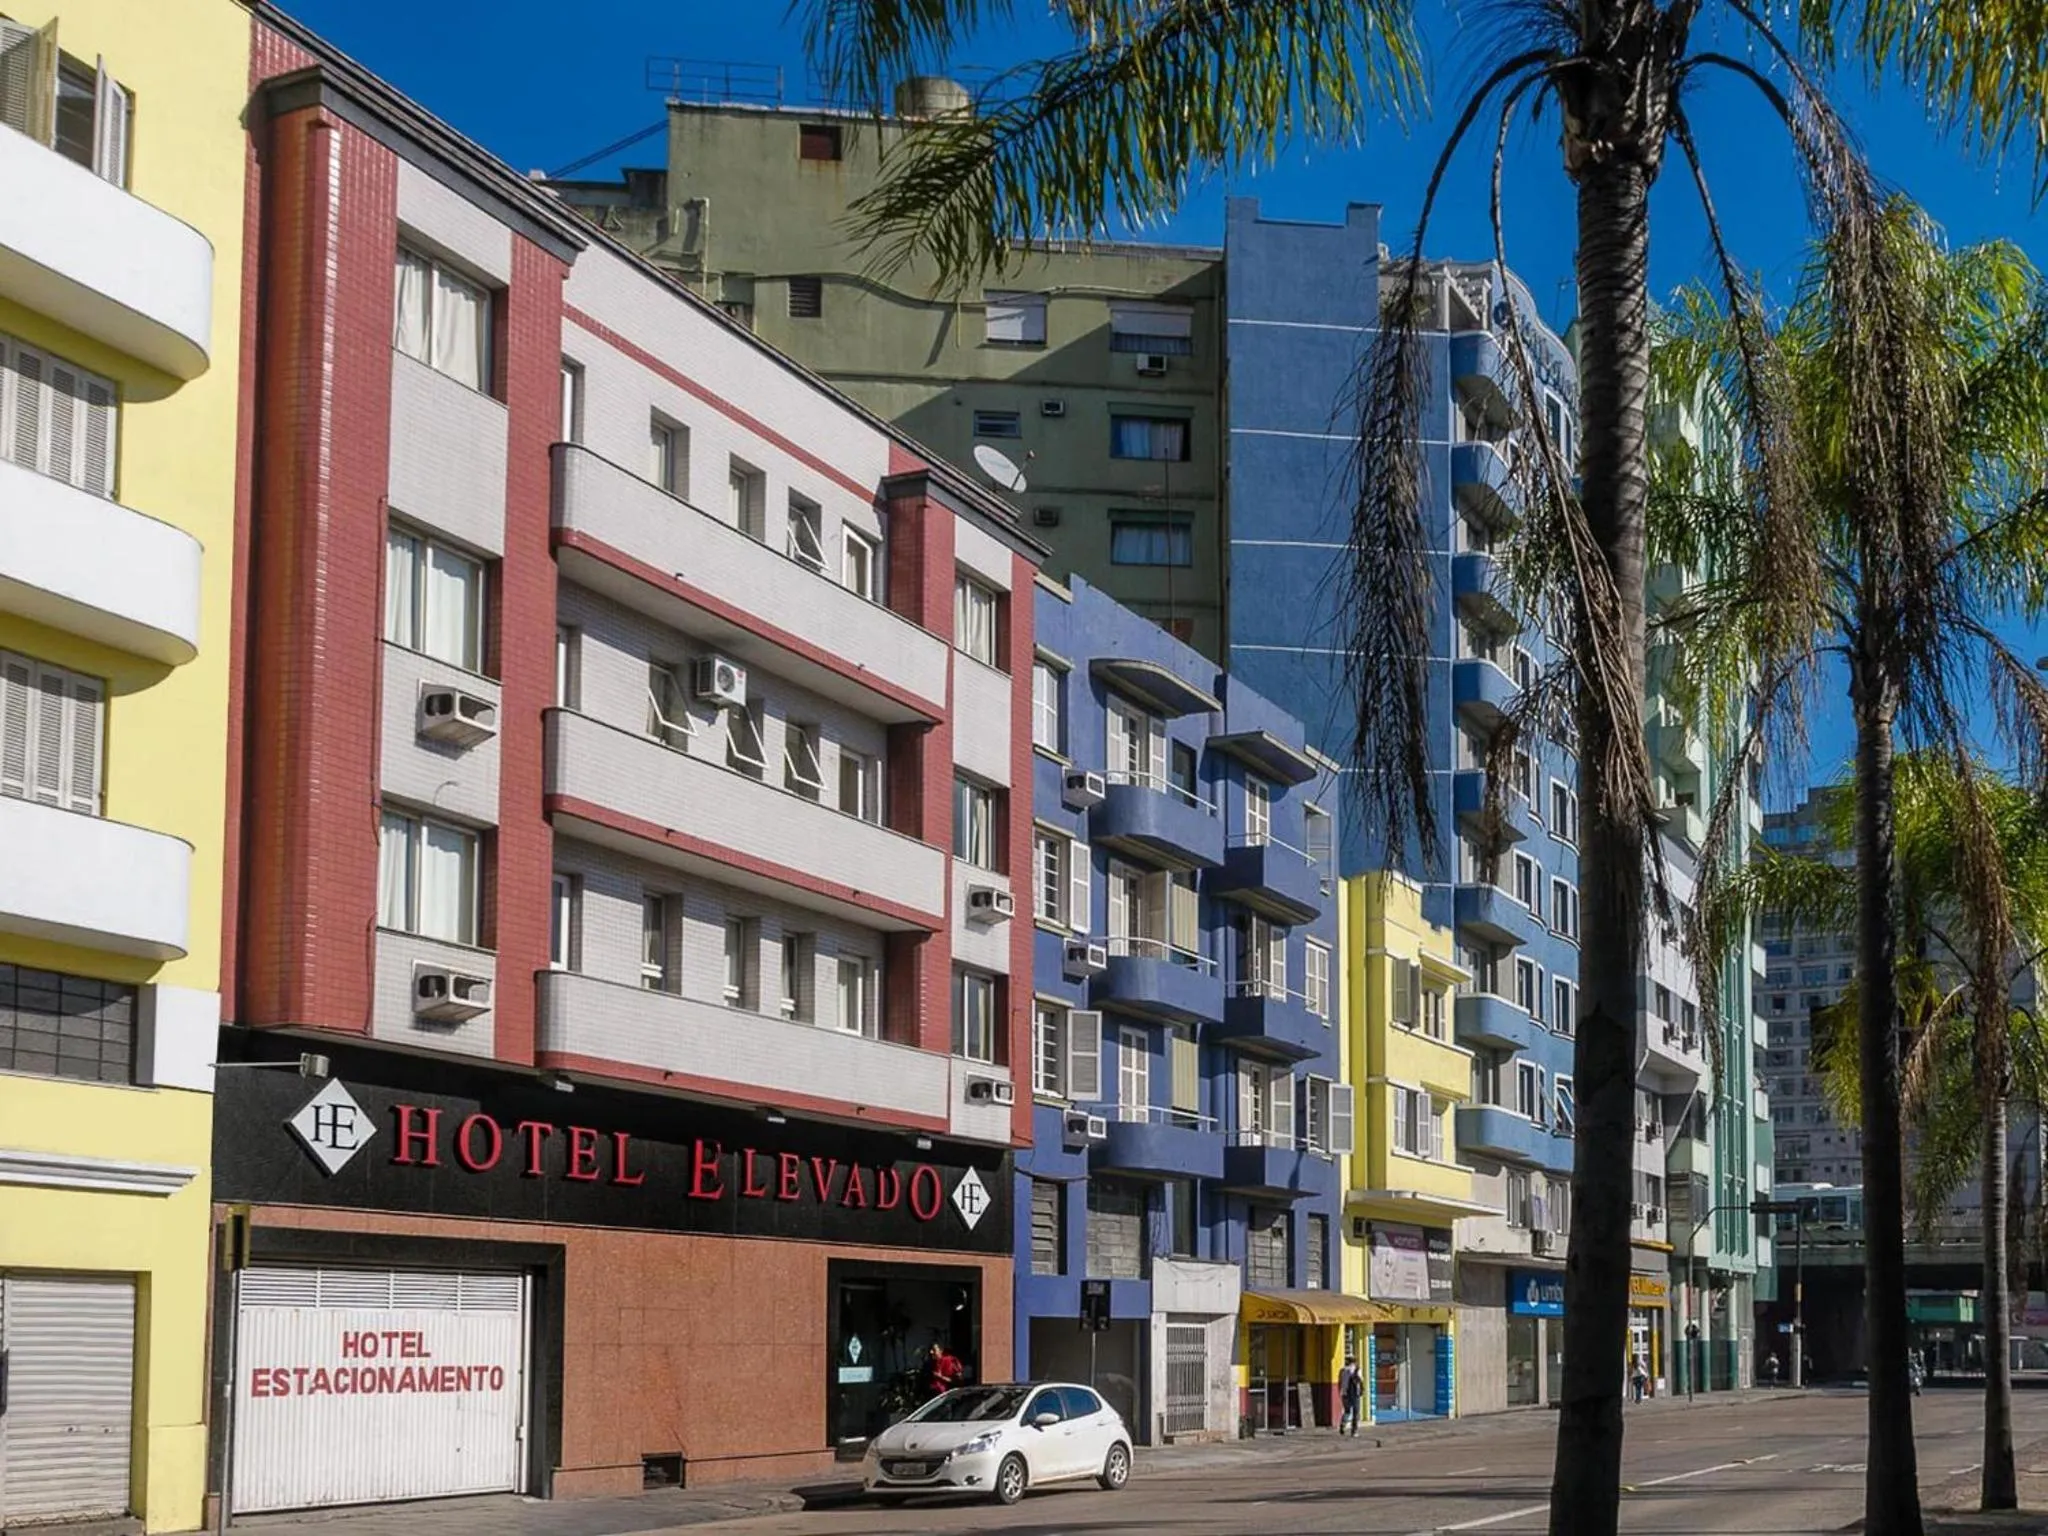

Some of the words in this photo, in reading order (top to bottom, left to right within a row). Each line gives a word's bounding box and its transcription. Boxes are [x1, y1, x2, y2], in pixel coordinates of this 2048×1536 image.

[391, 1103, 646, 1185] HOTEL
[688, 1139, 942, 1220] ELEVADO
[342, 1331, 431, 1358] HOTEL
[251, 1365, 504, 1398] ESTACIONAMENTO
